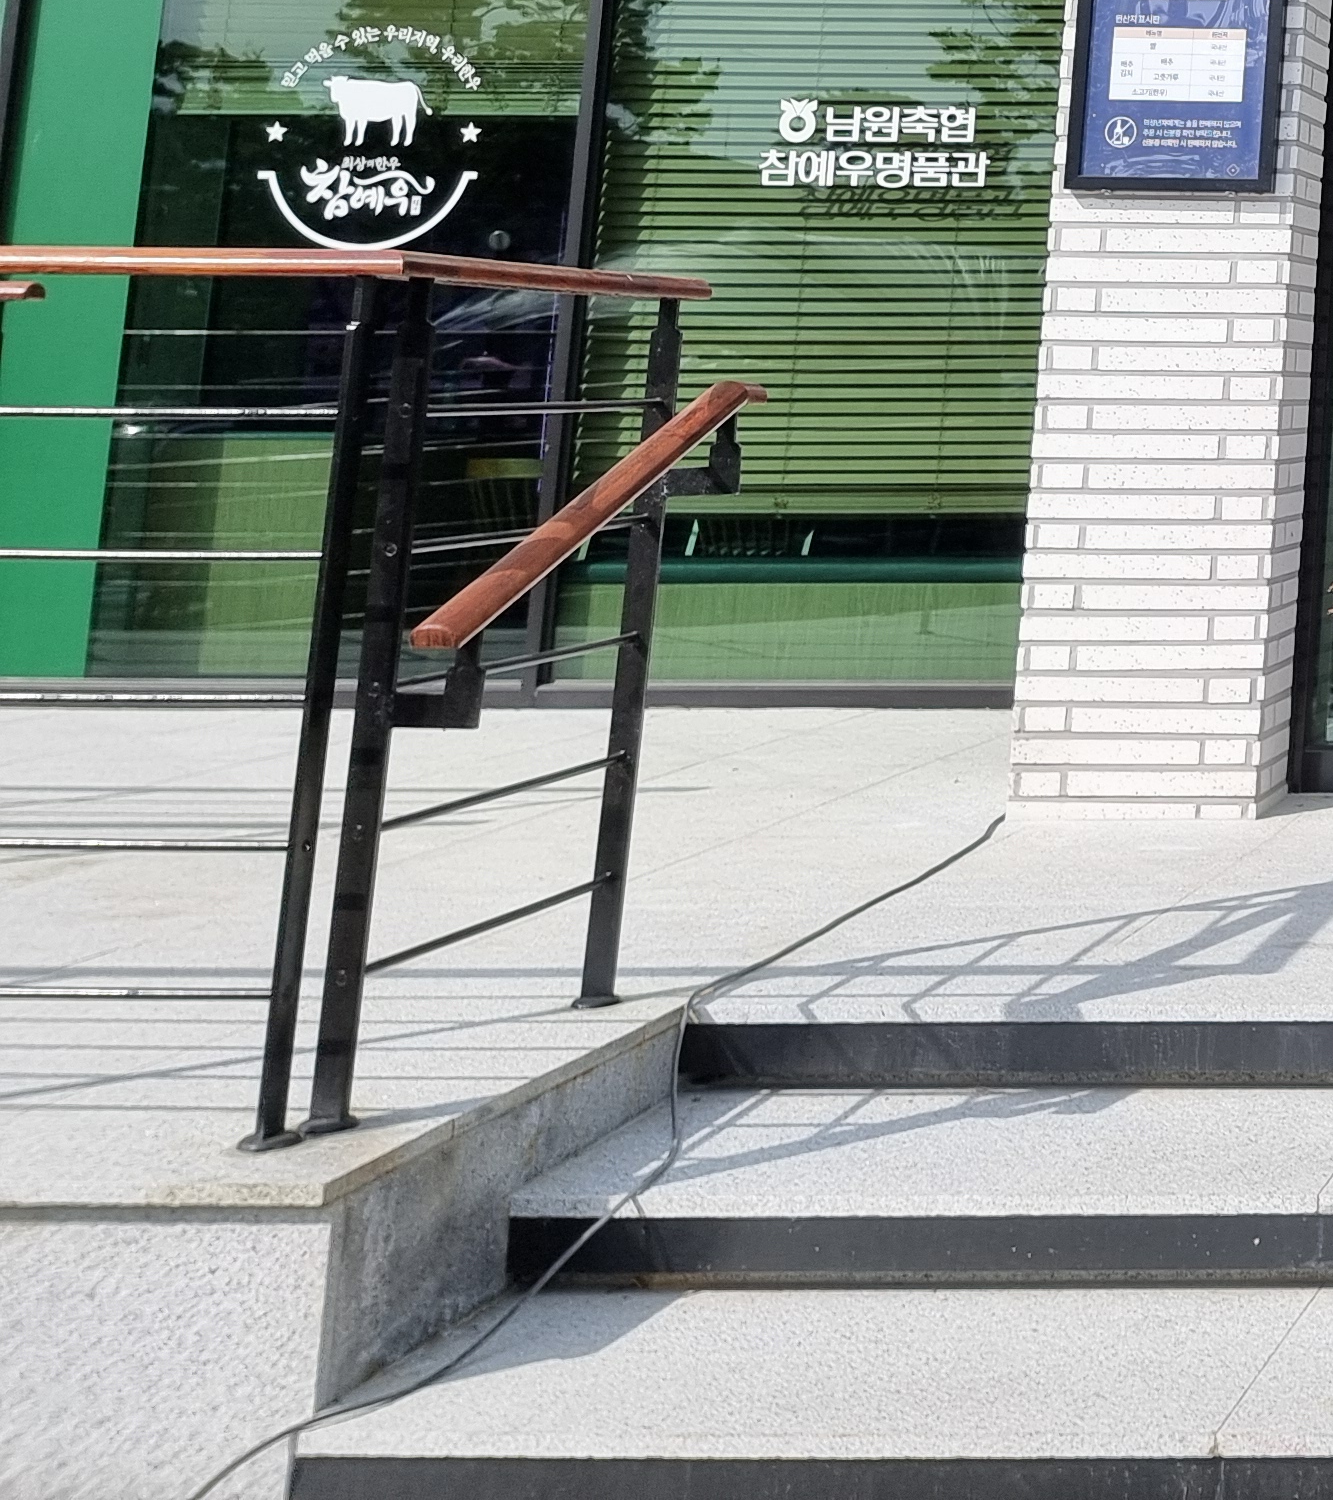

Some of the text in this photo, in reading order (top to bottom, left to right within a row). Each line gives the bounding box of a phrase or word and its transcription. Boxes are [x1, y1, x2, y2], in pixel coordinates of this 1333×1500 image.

[280, 62, 308, 88] 믿고
[304, 42, 334, 64] 먹을
[334, 33, 350, 51] 수
[351, 26, 382, 47] 있는
[441, 45, 482, 90] 우리한우
[825, 106, 976, 143] 남원축협
[300, 158, 412, 220] 참예우
[758, 149, 991, 189] 참예우명품관
